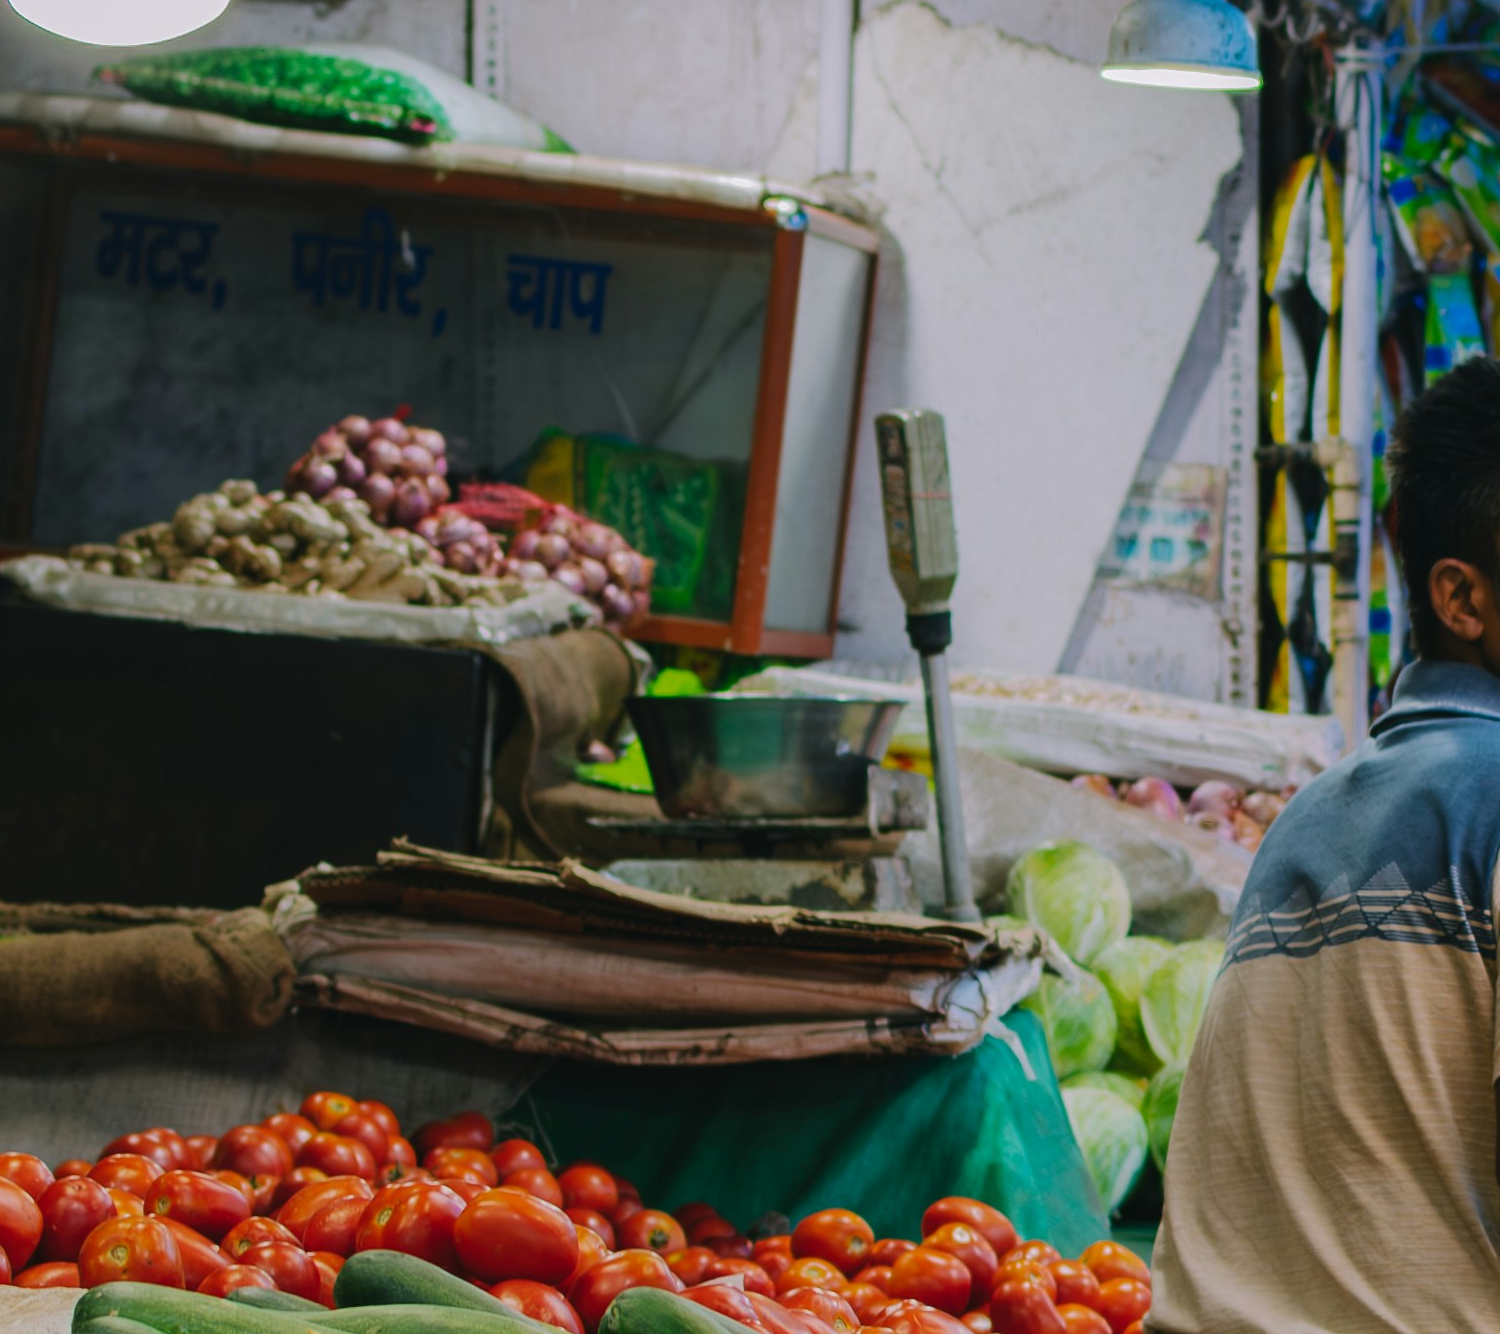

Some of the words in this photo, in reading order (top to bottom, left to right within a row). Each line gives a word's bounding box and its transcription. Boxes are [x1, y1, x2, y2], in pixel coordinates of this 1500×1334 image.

[95, 209, 228, 312] मटर,
[292, 204, 448, 338] पनीर,
[506, 253, 613, 336] चाप
